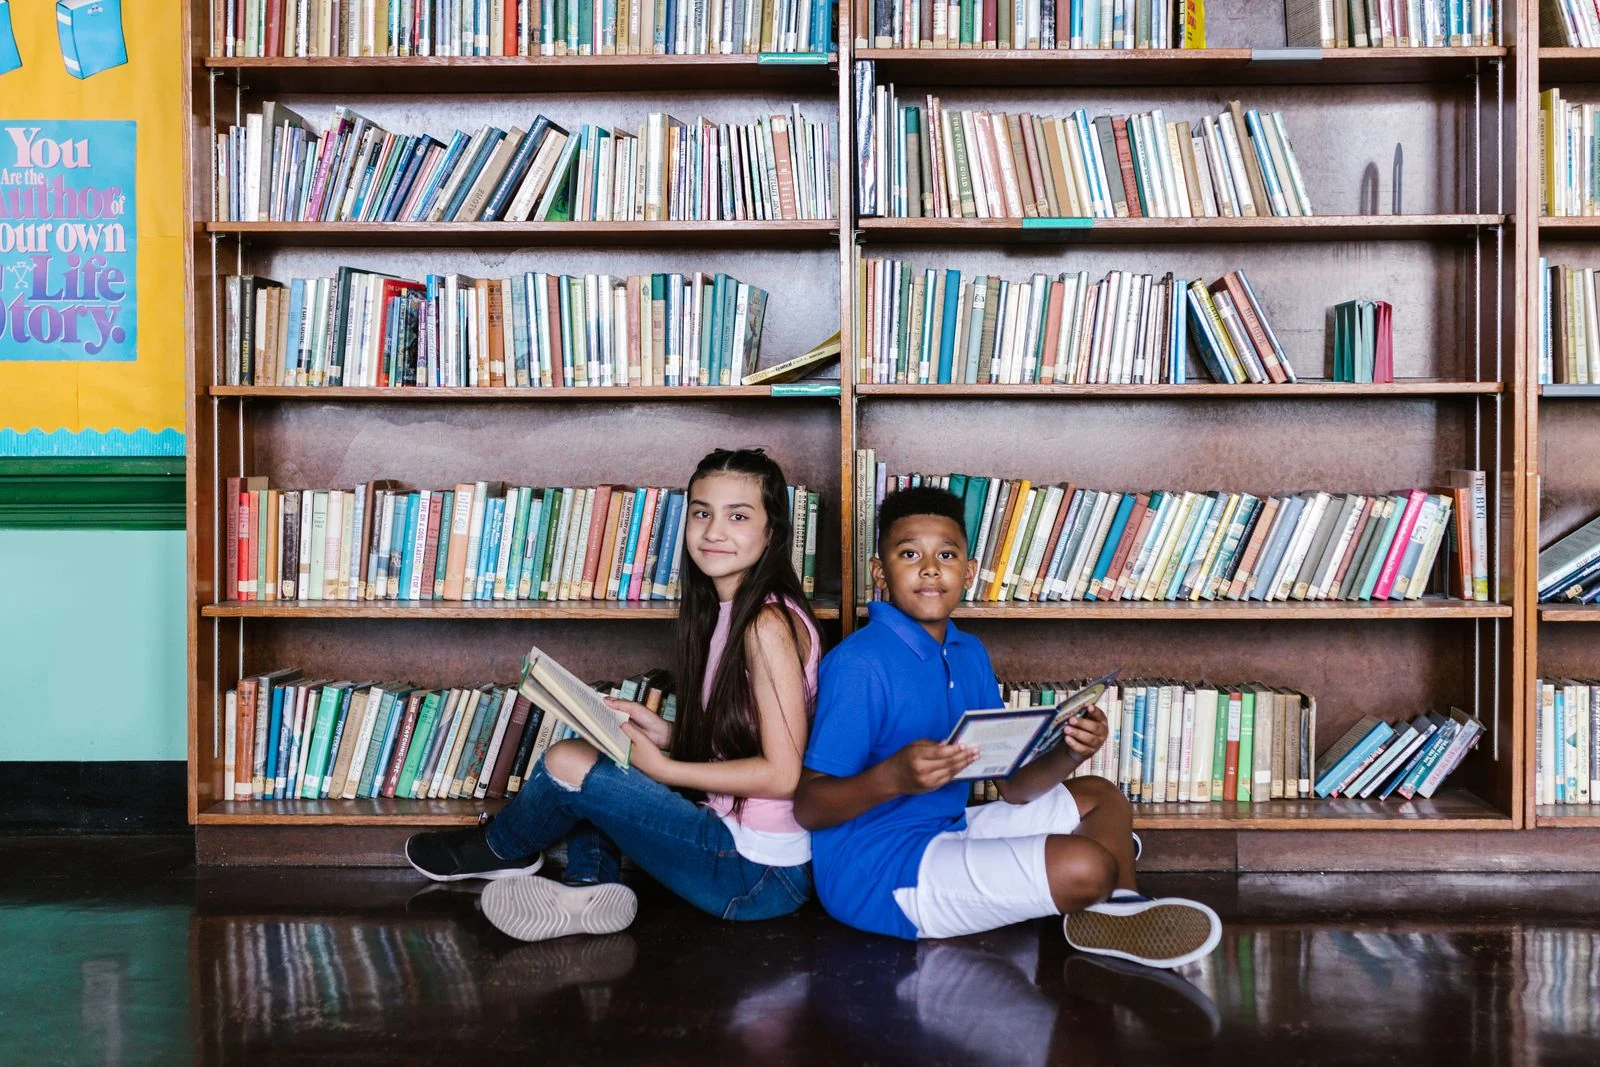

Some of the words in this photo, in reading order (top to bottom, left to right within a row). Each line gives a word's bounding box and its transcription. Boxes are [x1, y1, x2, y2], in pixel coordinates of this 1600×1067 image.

[5, 127, 91, 169] You
[954, 133, 963, 153] FORT
[958, 154, 965, 164] OF
[1, 169, 21, 186] Are
[22, 169, 45, 186] the
[959, 166, 968, 187] GOLD
[110, 195, 126, 216] of
[466, 186, 485, 215] ALONE
[0, 223, 53, 253] our
[56, 223, 128, 253] own
[28, 253, 127, 302] Life
[1250, 324, 1268, 348] RIDE
[858, 473, 866, 498] Morgan
[1475, 475, 1485, 494] The
[420, 501, 428, 513] LIFE
[623, 506, 632, 528] MYSTERY
[1475, 496, 1485, 520] BFG
[796, 524, 805, 548] TIGERS
[617, 546, 625, 564] BURIED
[398, 725, 411, 756] CATCHING
[536, 726, 549, 750] SMOKE
[393, 758, 402, 774] FIRE
